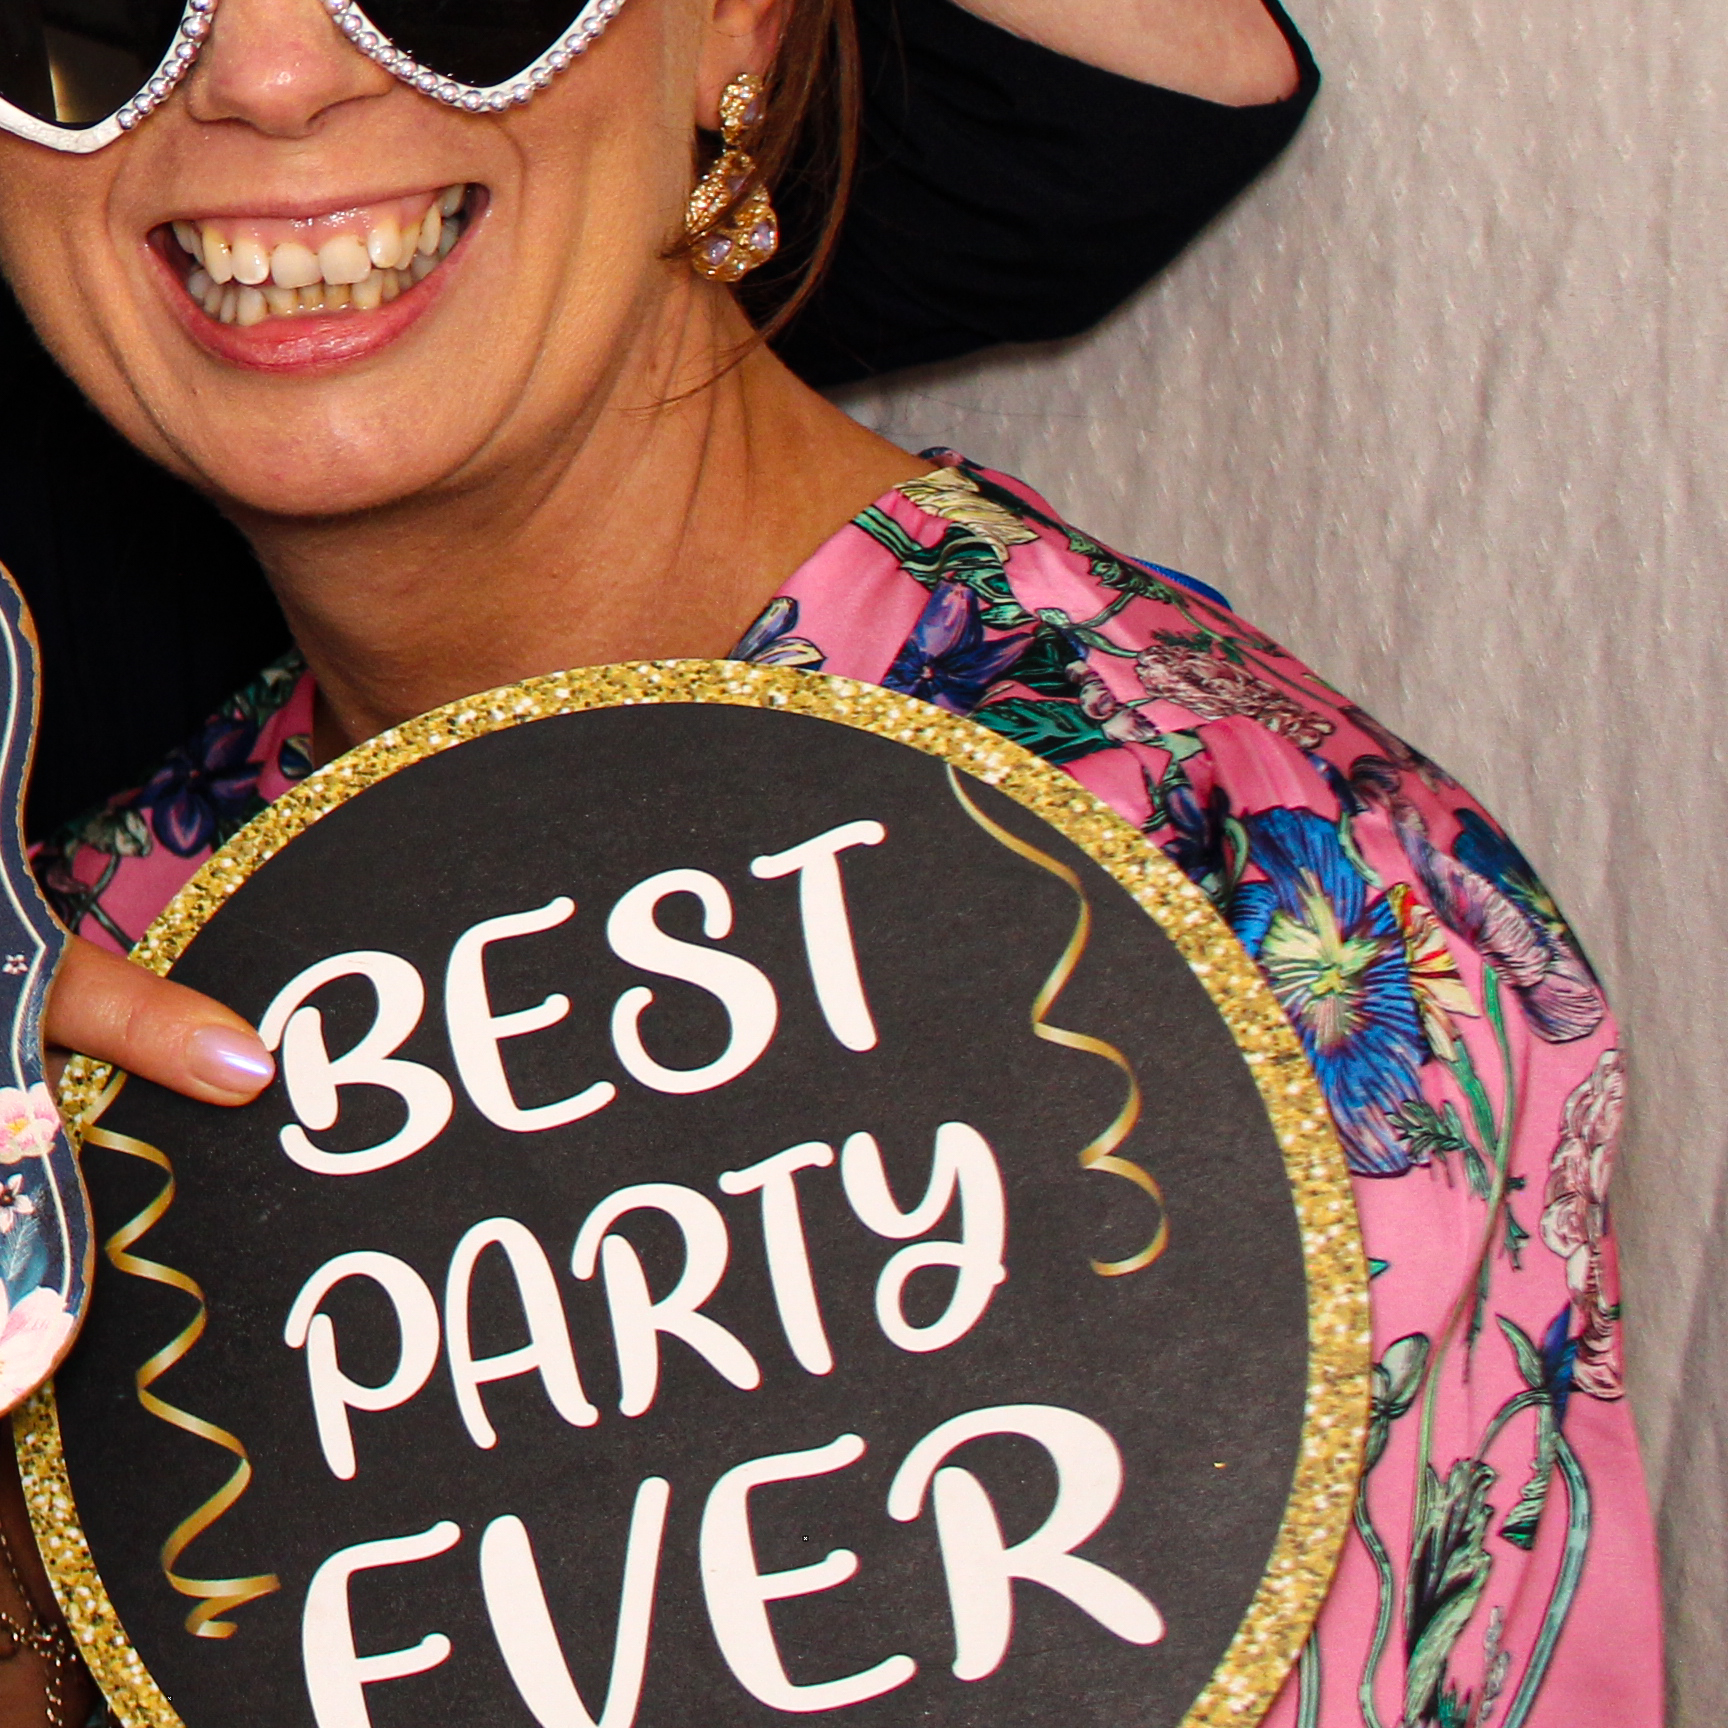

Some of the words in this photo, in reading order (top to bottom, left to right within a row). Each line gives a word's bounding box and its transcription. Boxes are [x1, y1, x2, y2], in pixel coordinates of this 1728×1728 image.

[258, 820, 885, 1175] BEST
[284, 1122, 1006, 1480] PARTY
[302, 1403, 1164, 1728] EVER
